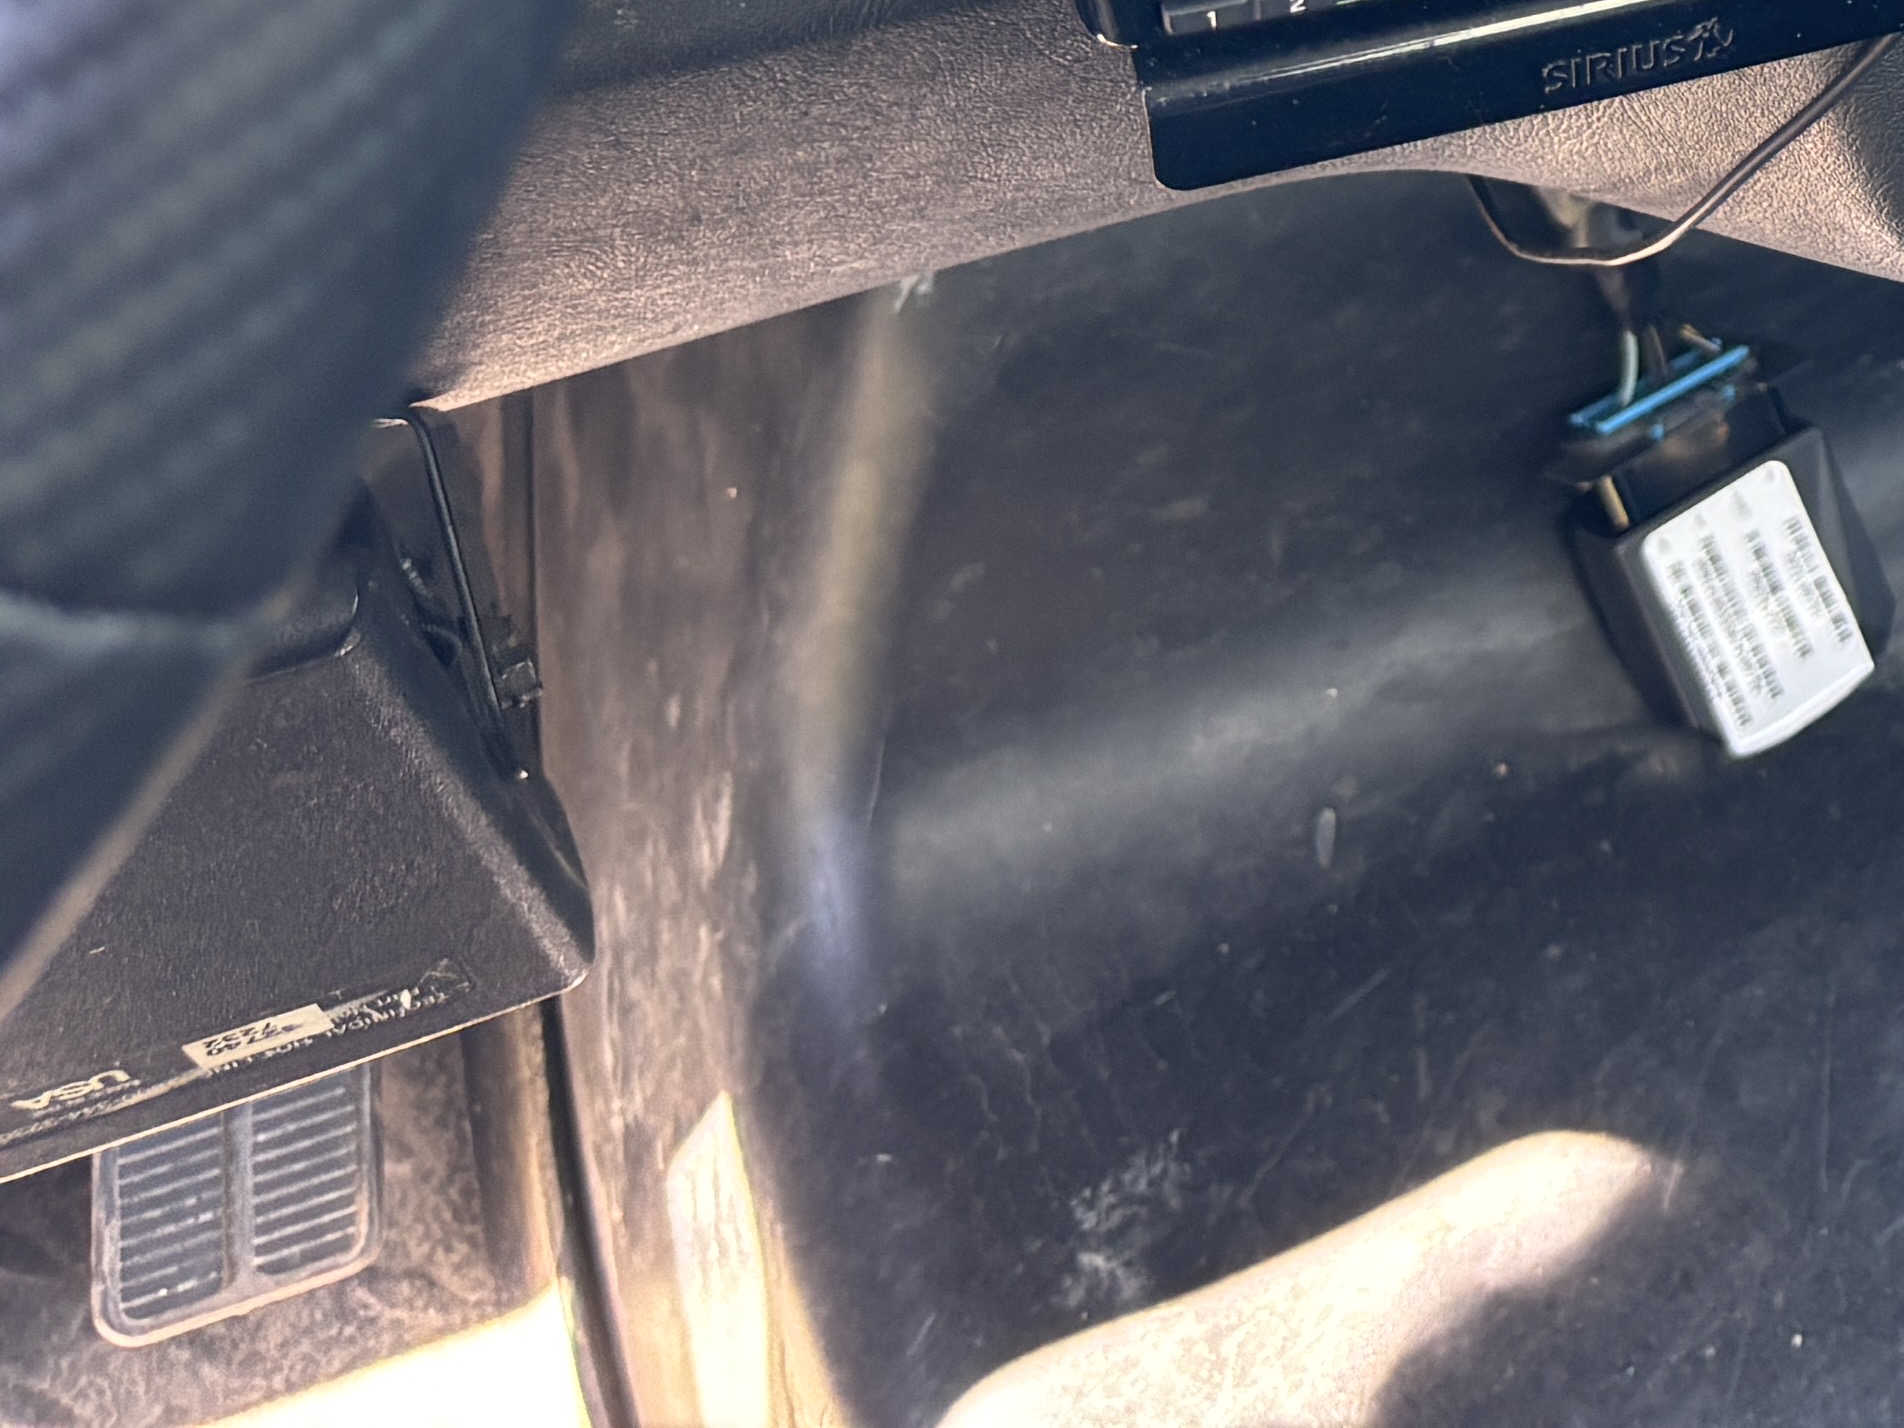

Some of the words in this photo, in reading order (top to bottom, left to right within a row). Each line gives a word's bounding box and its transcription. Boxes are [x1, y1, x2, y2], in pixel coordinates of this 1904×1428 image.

[1206, 10, 1219, 29] 1
[1542, 34, 1687, 94] SIRIUS
[10, 1069, 132, 1110] USA
